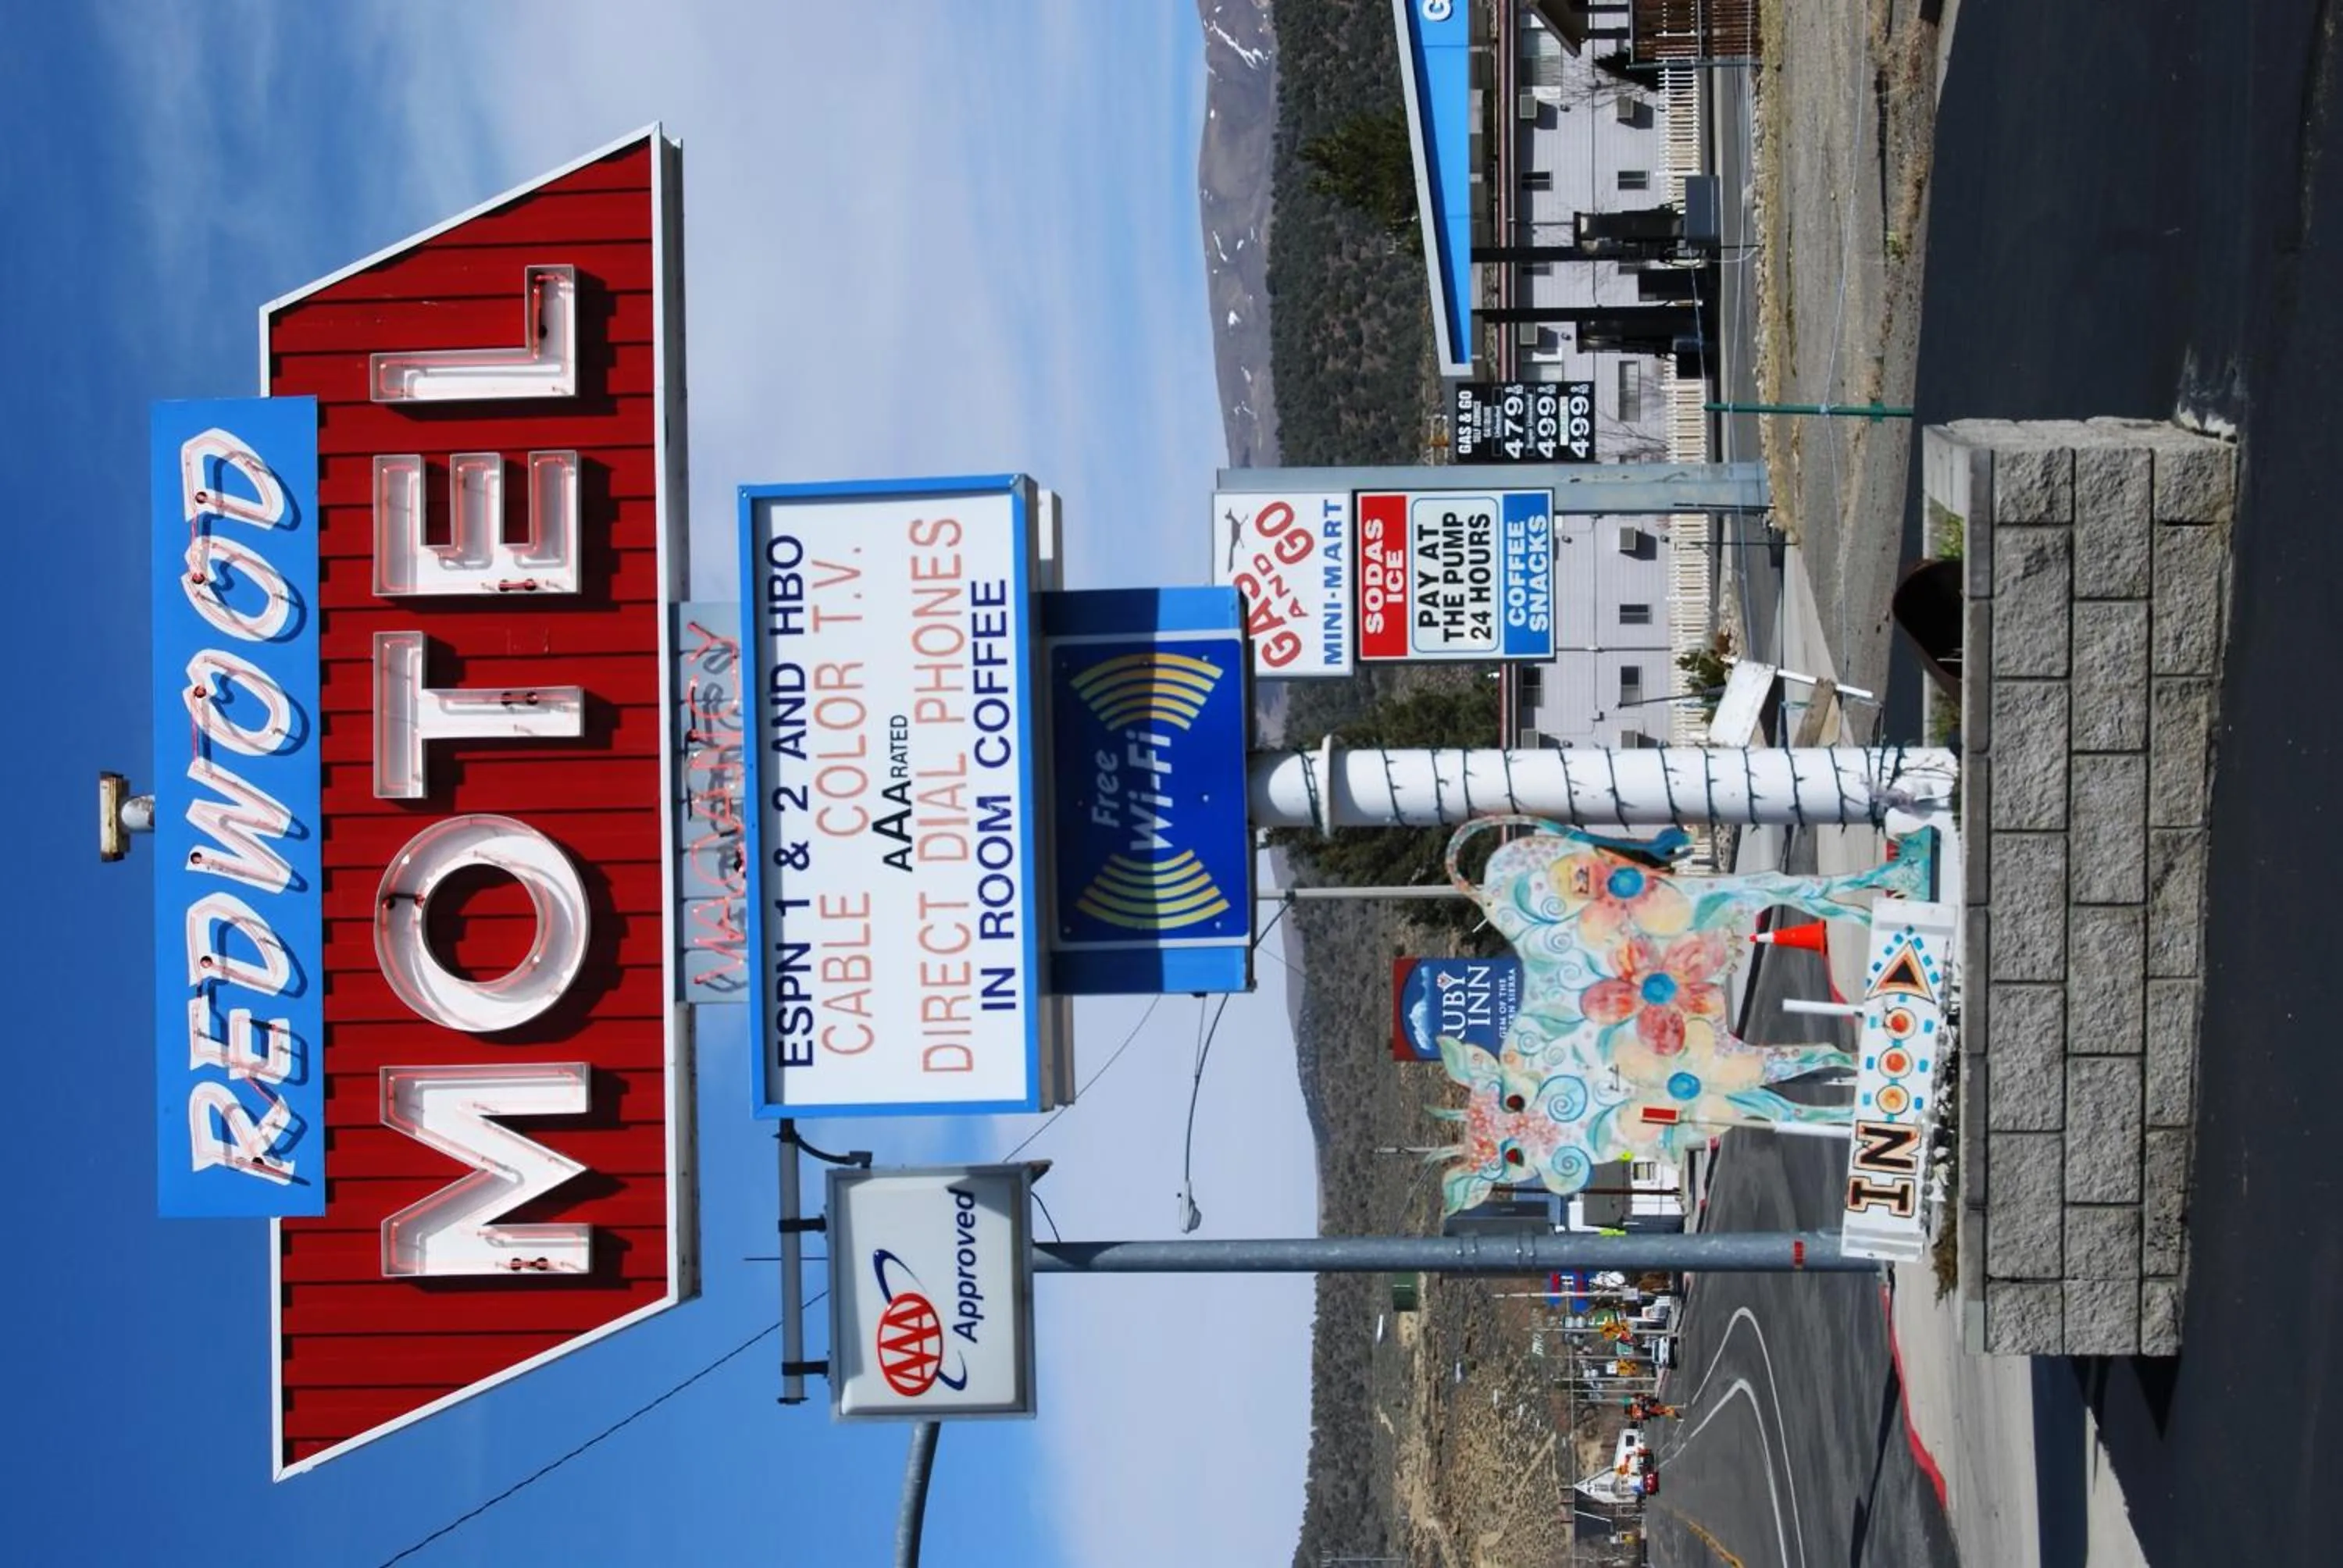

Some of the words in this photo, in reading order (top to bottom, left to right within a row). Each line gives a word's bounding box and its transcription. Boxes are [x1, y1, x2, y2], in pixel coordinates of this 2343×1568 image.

[1458, 390, 1472, 408] GO
[1458, 412, 1472, 422] &
[1458, 426, 1472, 453] GAS
[1504, 395, 1524, 458] 479
[1537, 395, 1557, 458] 499
[1570, 395, 1589, 458] 499
[1254, 500, 1315, 565] GO
[1417, 523, 1439, 560] AT
[1443, 511, 1465, 585] PUMP
[1468, 512, 1492, 602] HOURS
[1507, 520, 1526, 626] COFFEE
[1528, 514, 1549, 631] SNACKS
[766, 533, 804, 634] HBO
[811, 545, 862, 633] T.V.
[1253, 552, 1310, 617] AND
[1322, 498, 1343, 665] MINI-MART
[1364, 517, 1385, 633] SODAS
[1385, 548, 1404, 602] ICE
[1418, 569, 1440, 627] PAY
[908, 516, 965, 723] PHONES
[1443, 592, 1465, 642] THE
[1469, 609, 1492, 640] 24
[769, 661, 807, 760] AND
[970, 578, 1011, 768] COFFEE
[371, 263, 590, 1277] MOTEL
[813, 661, 869, 837] COLOR
[889, 714, 909, 778] RATED
[180, 426, 295, 1184] REDWOOD
[683, 621, 745, 984] VACANCY
[772, 784, 808, 811] 2
[915, 752, 969, 861] DIAL
[1091, 749, 1120, 827] Free
[1125, 729, 1174, 850] Wi-Fi
[773, 839, 809, 871] &
[975, 794, 1015, 939] ROOM
[776, 896, 810, 916] 1
[776, 942, 814, 1067] ESPN
[818, 890, 875, 1055] CABLE
[918, 891, 974, 1072] DIRECT
[979, 966, 1017, 1010] IN
[1437, 970, 1466, 1039] UBY
[1467, 964, 1491, 1025] INN
[1499, 1000, 1506, 1014] OF
[1845, 1119, 1921, 1217] IN
[943, 1185, 984, 1344] Approved
[878, 1297, 941, 1389] AAA
